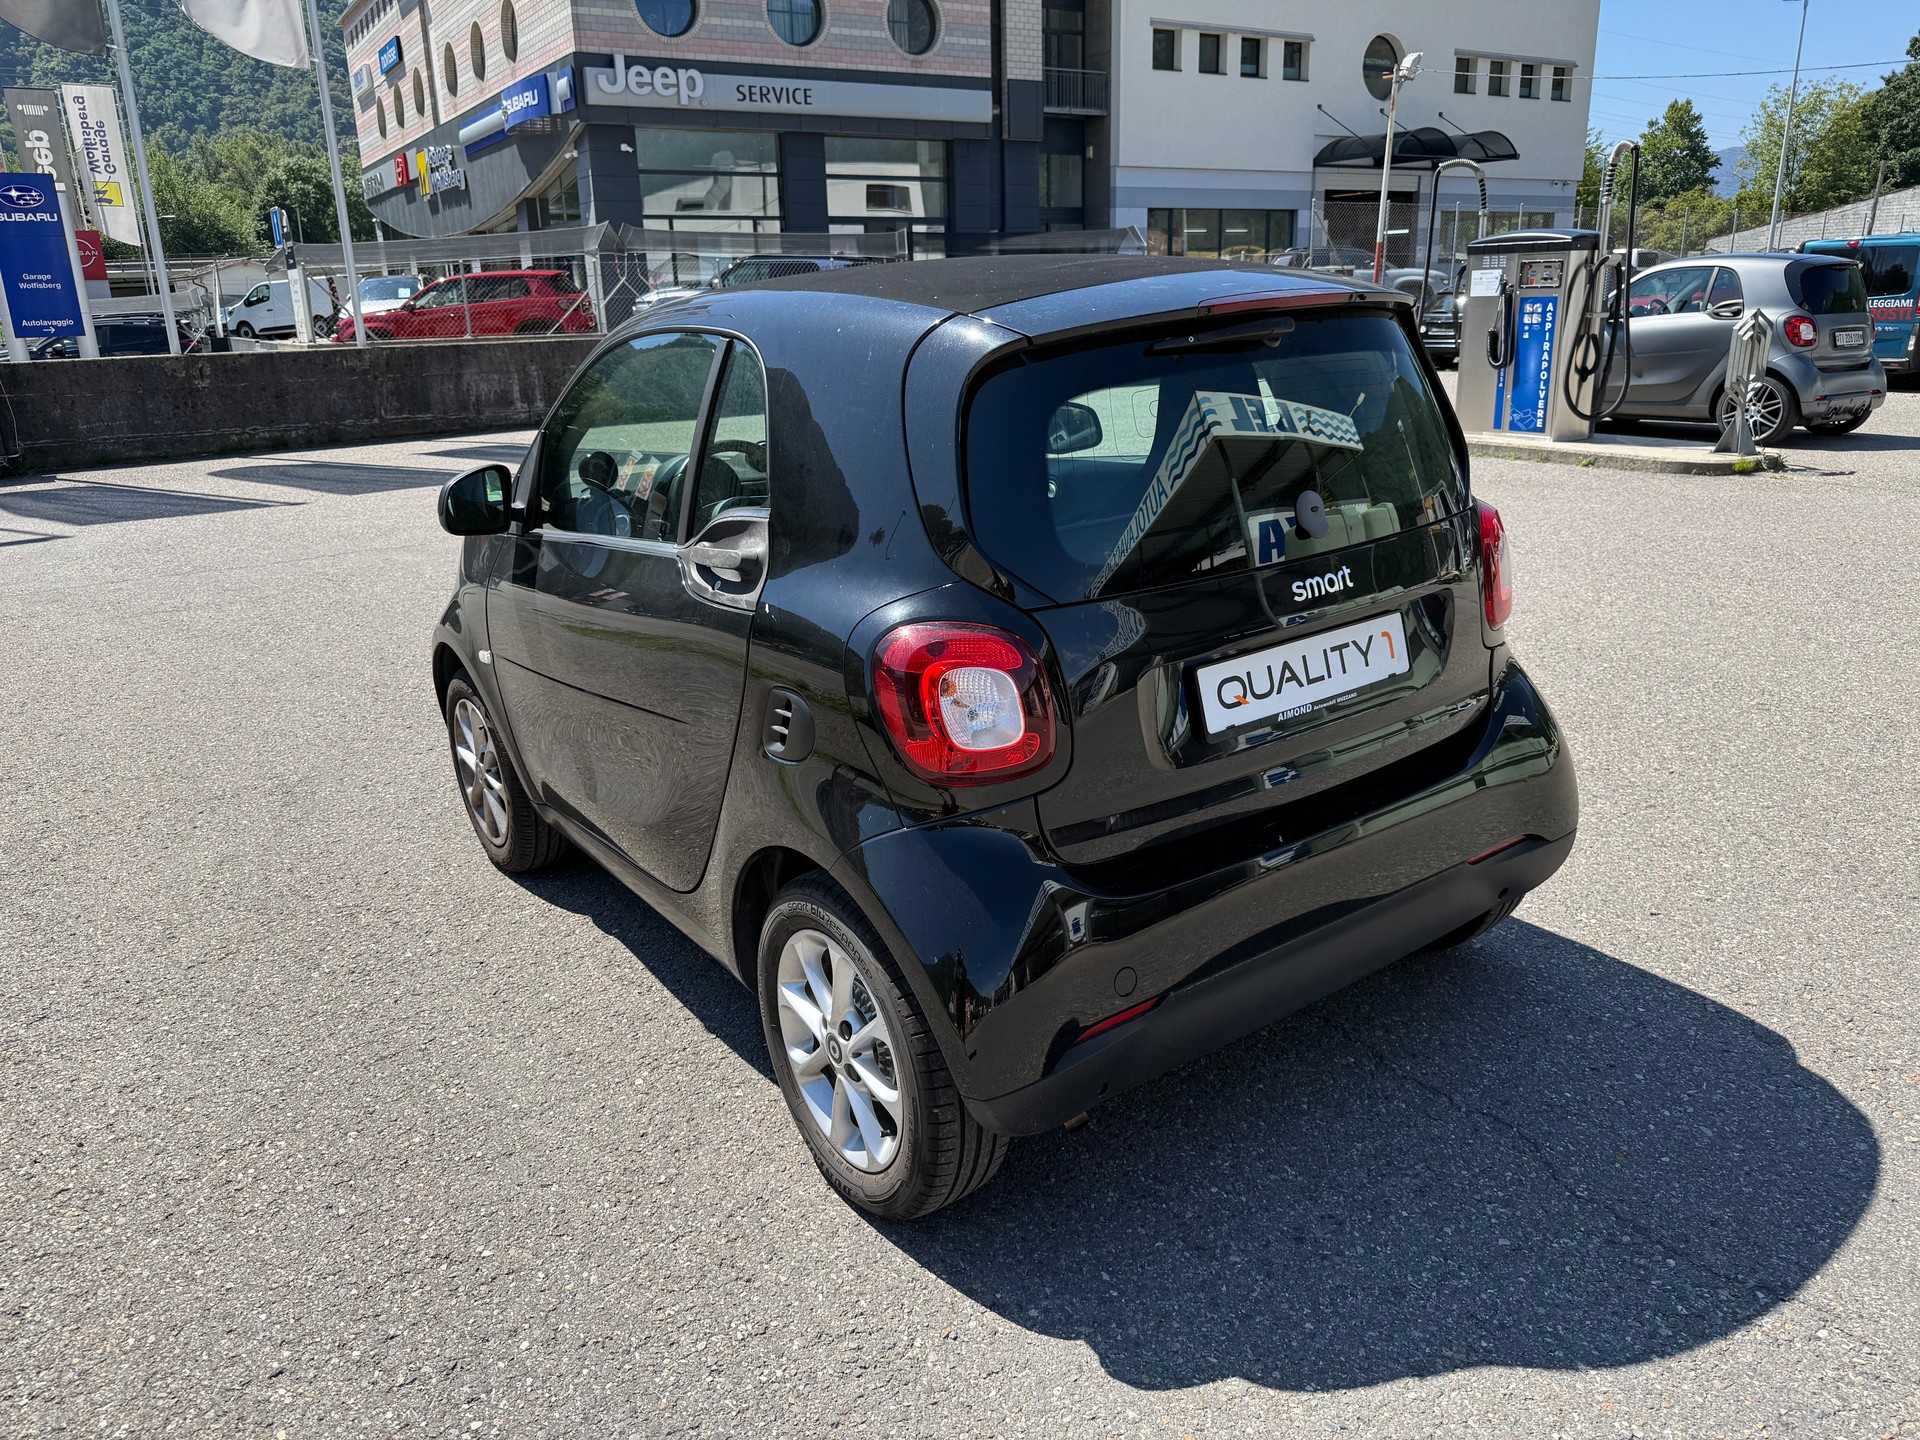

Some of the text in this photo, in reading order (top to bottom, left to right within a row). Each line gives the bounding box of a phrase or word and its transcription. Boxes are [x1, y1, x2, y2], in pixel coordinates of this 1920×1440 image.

[597, 53, 812, 106] Jeep SERVICE
[505, 89, 538, 115] SUBARU
[18, 282, 62, 290] Wolfisberg
[22, 273, 52, 281] Garage
[22, 319, 74, 327] Autolavaggio
[1536, 302, 1554, 428] ASPIRAPOLVERE
[1291, 565, 1354, 602] smart
[1216, 634, 1374, 710] QUALITY
[1277, 703, 1313, 722] AIMOND
